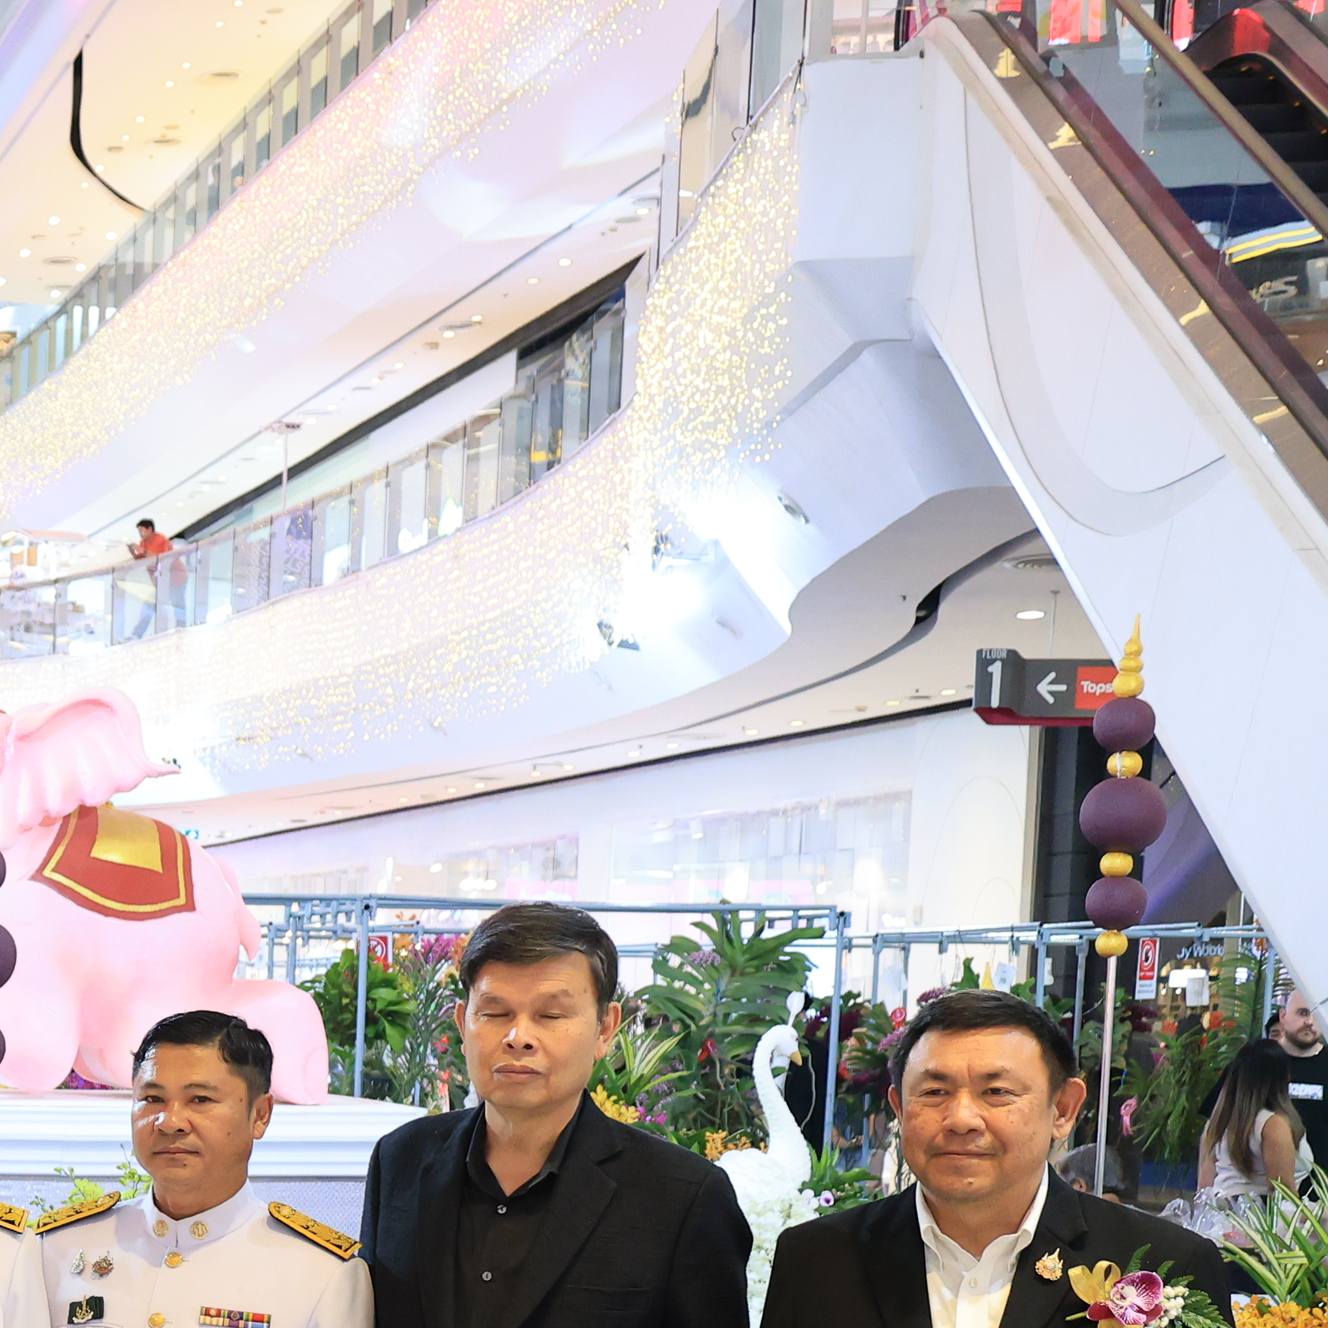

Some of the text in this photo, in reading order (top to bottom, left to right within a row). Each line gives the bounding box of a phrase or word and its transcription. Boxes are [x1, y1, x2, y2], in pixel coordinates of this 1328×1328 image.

[981, 649, 1008, 659] FLOOR
[986, 660, 1003, 708] 1
[1080, 680, 1114, 696] Tops
